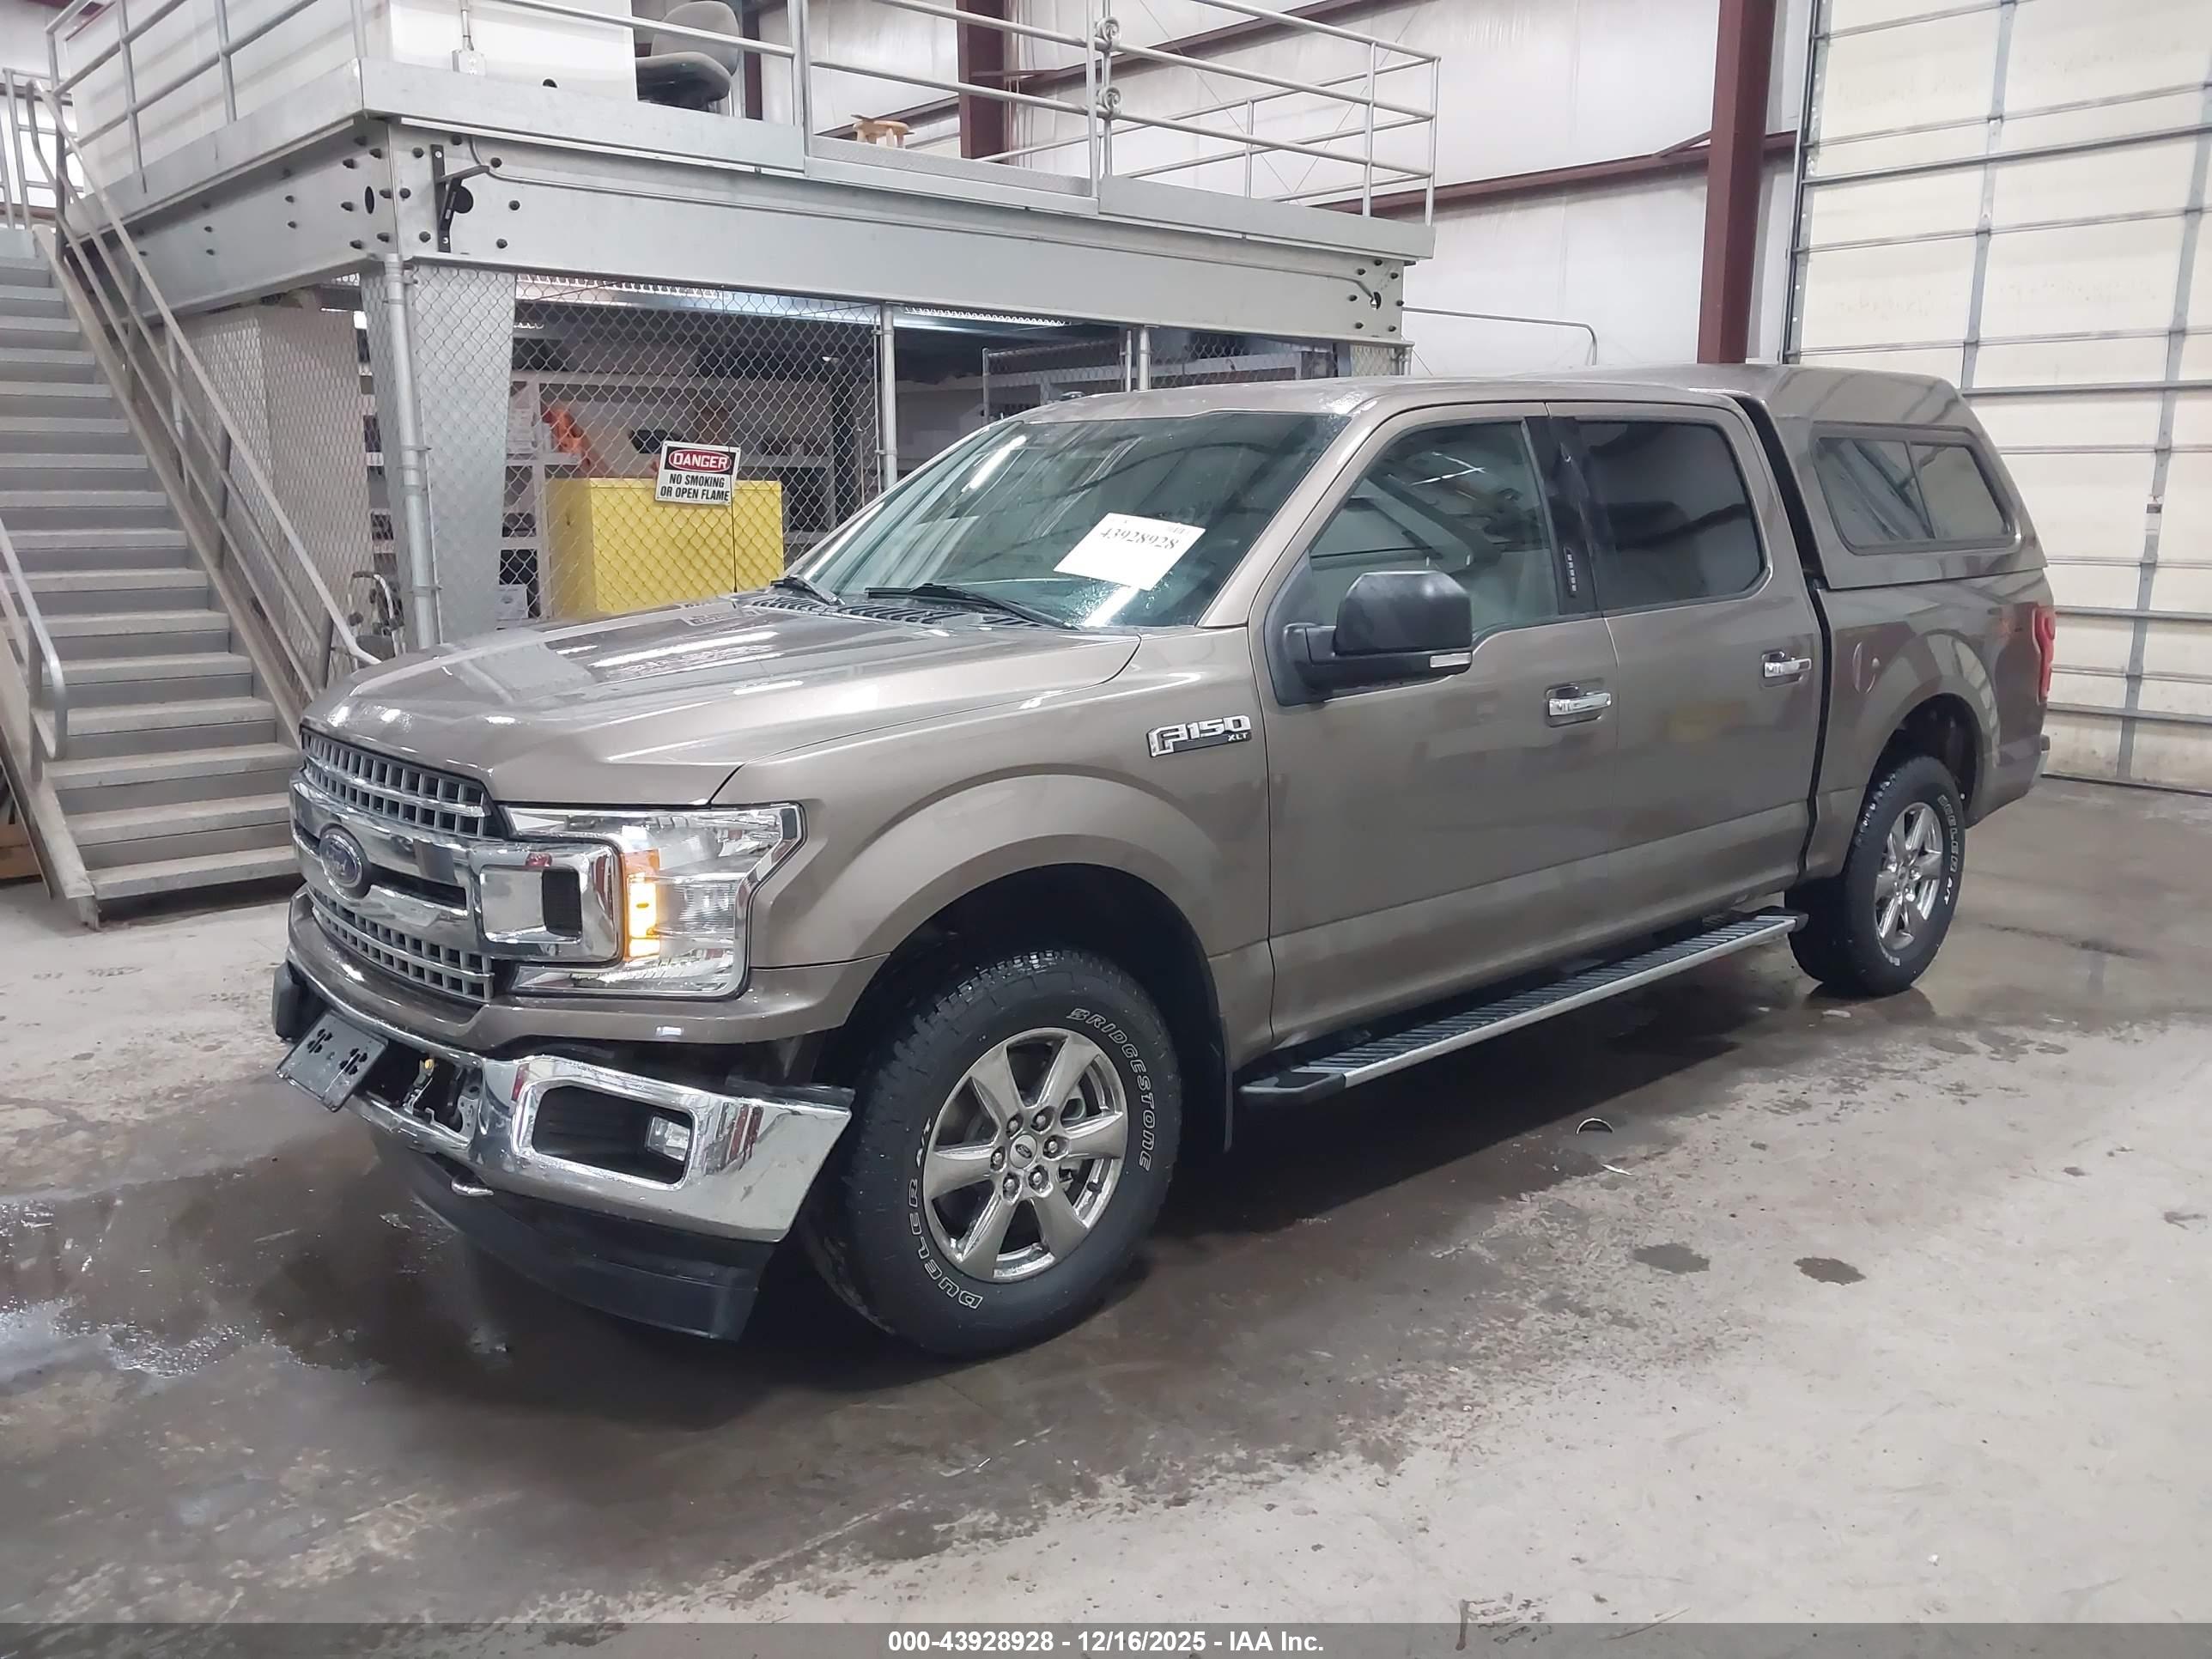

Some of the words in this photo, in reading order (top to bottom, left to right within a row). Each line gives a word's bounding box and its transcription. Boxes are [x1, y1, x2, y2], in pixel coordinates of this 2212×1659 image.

[672, 453, 728, 469] DANGER
[669, 473, 683, 485] NO
[684, 474, 726, 488] SMOKING
[659, 485, 673, 497] OR
[675, 487, 699, 499] OPEN
[701, 489, 730, 501] FLAME
[1100, 527, 1180, 550] 43928928
[1227, 732, 1249, 742] XLT
[1066, 1007, 1156, 1172] BRIDGESTONE
[908, 1178, 983, 1310] DUELER
